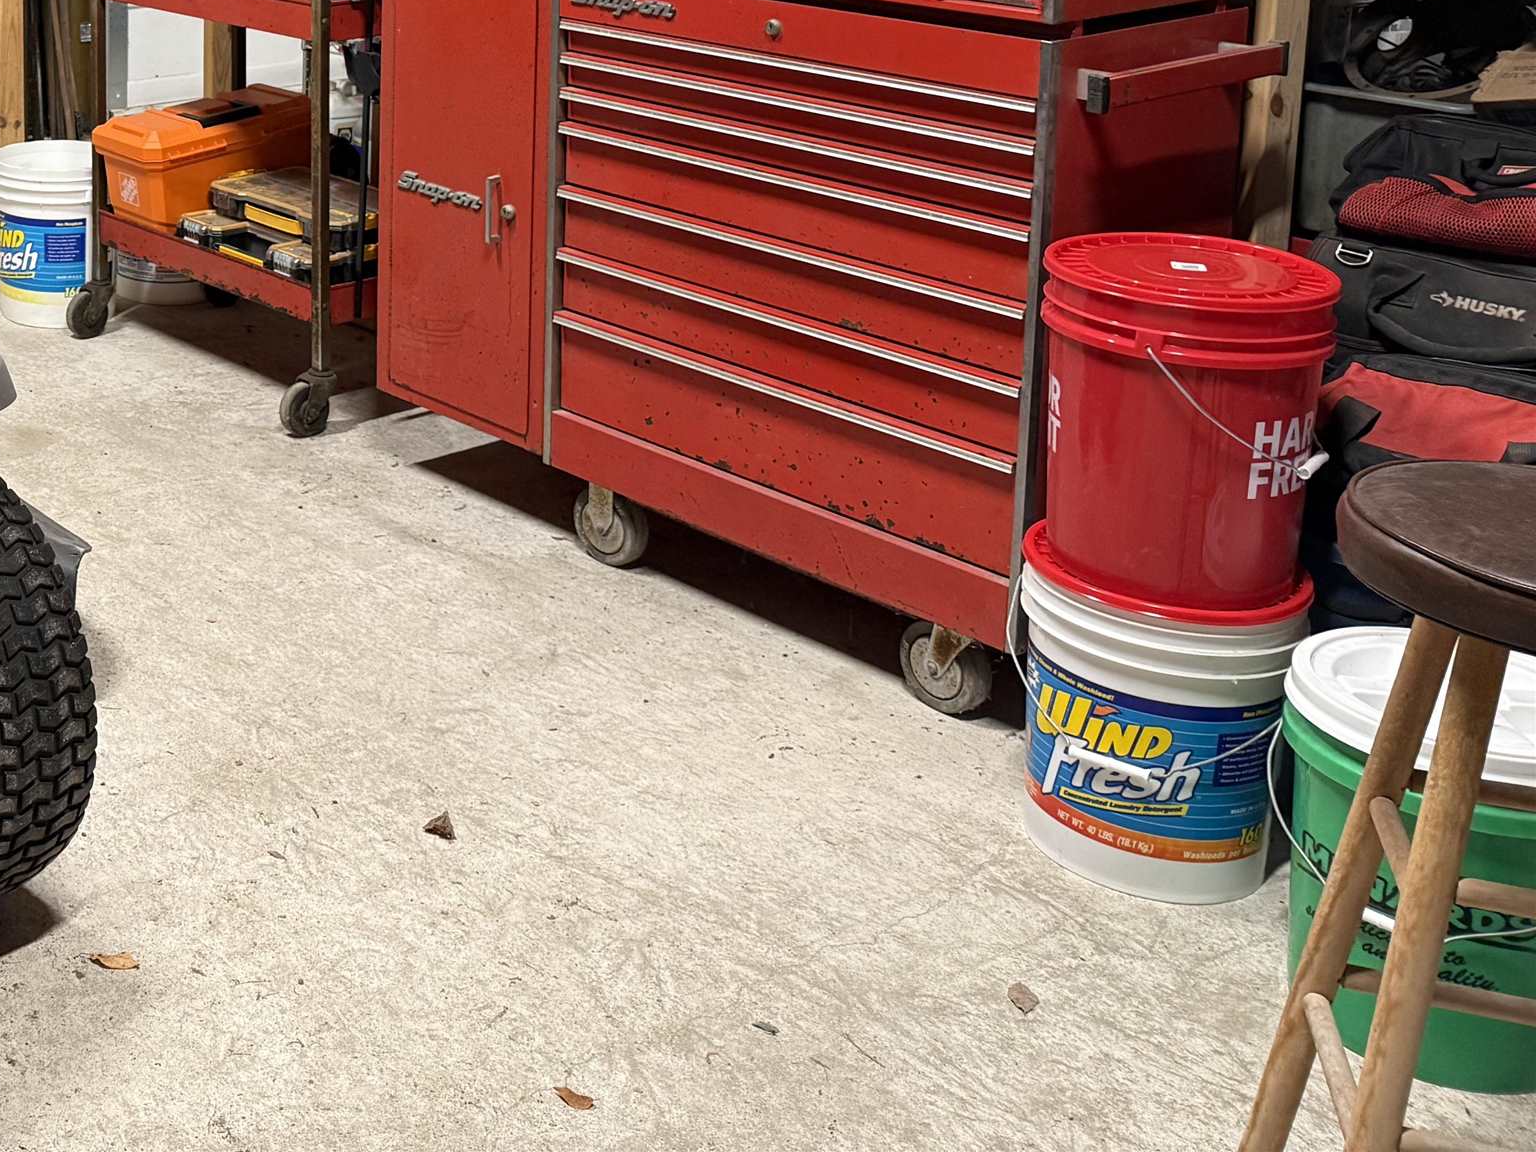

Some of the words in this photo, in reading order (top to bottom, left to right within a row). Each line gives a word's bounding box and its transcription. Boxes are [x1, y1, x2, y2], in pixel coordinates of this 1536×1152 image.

[398, 170, 483, 210] Snap-on
[0, 242, 38, 271] resh
[1454, 294, 1527, 321] HUSKY
[1041, 734, 1202, 802] Fresh
[1057, 808, 1069, 822] NET
[1086, 825, 1096, 835] 40
[1443, 951, 1466, 966] to
